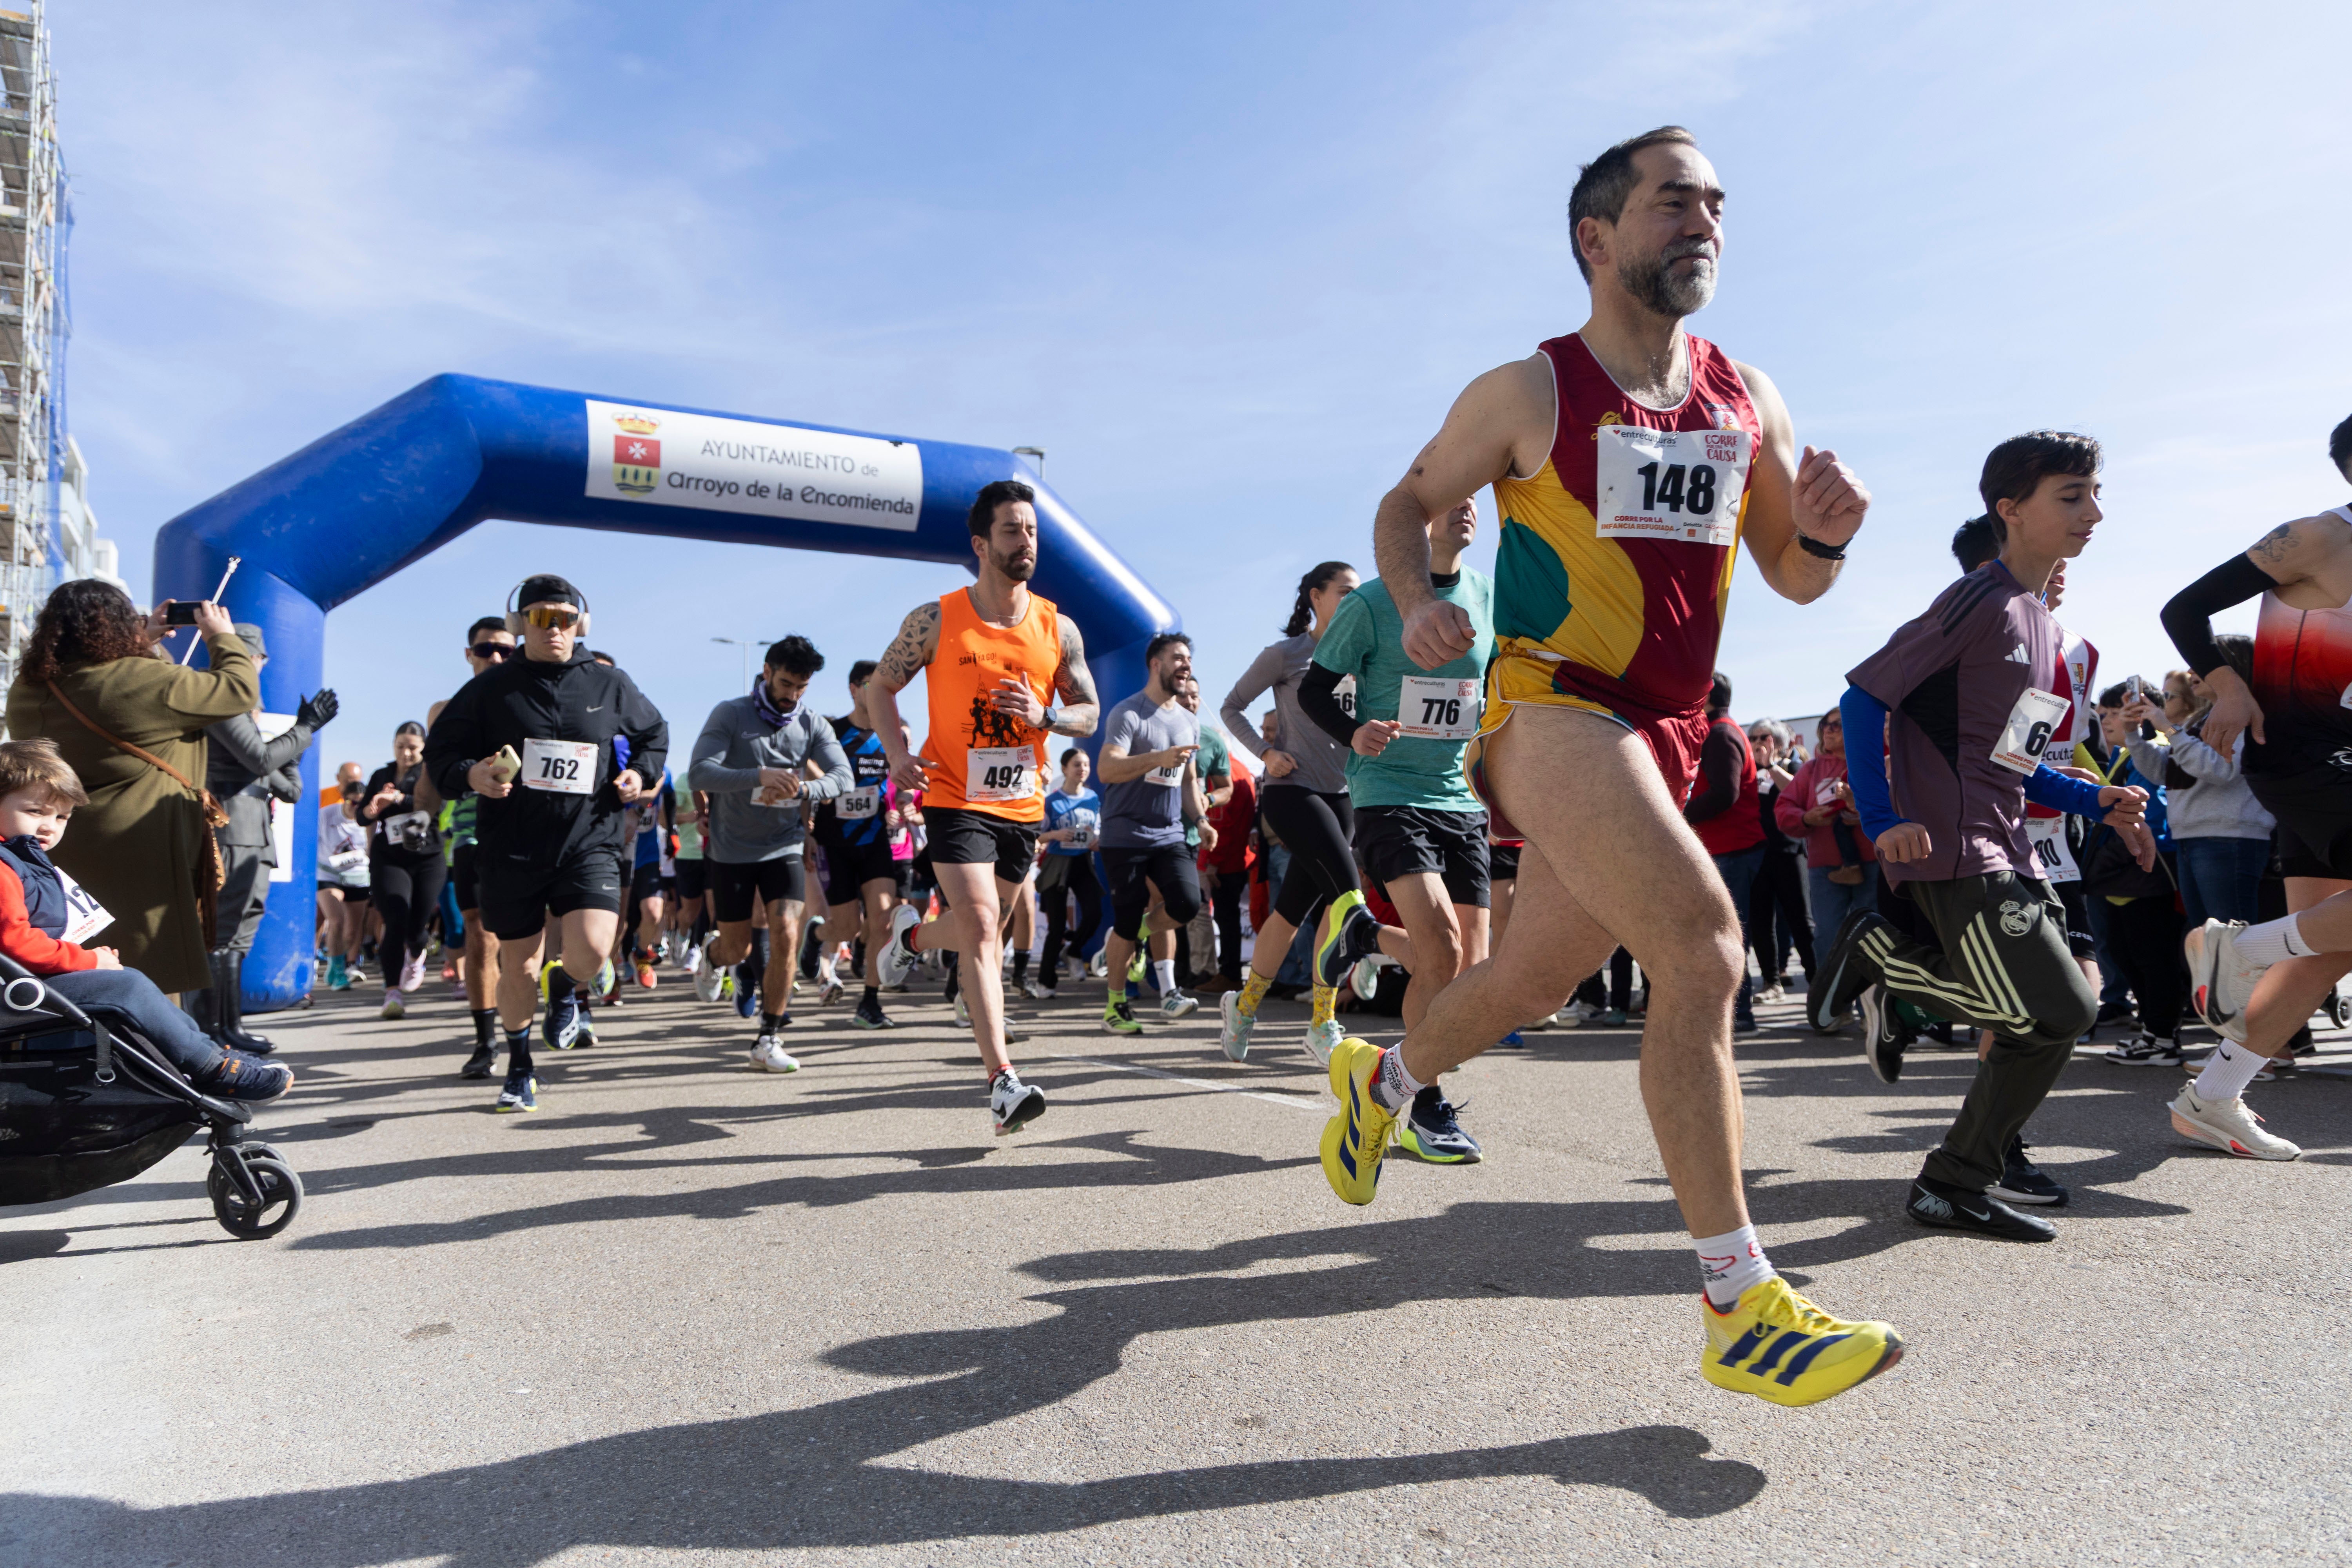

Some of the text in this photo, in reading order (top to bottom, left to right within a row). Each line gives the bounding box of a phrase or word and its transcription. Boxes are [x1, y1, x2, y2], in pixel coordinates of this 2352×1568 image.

[1621, 431, 1676, 444] entreculturas
[1704, 434, 1739, 447] CORRE
[701, 439, 879, 476] AYUNTAMIENTO de
[1706, 449, 1737, 462] CAUSA
[746, 479, 770, 498] de
[777, 482, 793, 501] la
[1637, 462, 1716, 515] 148
[1421, 698, 1460, 725] 776
[2025, 721, 2058, 757] 6
[1994, 753, 2019, 766] INFANCIA
[2006, 752, 2024, 761] CORRE
[541, 757, 579, 780] 762
[983, 764, 1024, 789] 492
[846, 797, 871, 811] 564
[1071, 831, 1087, 842] 43
